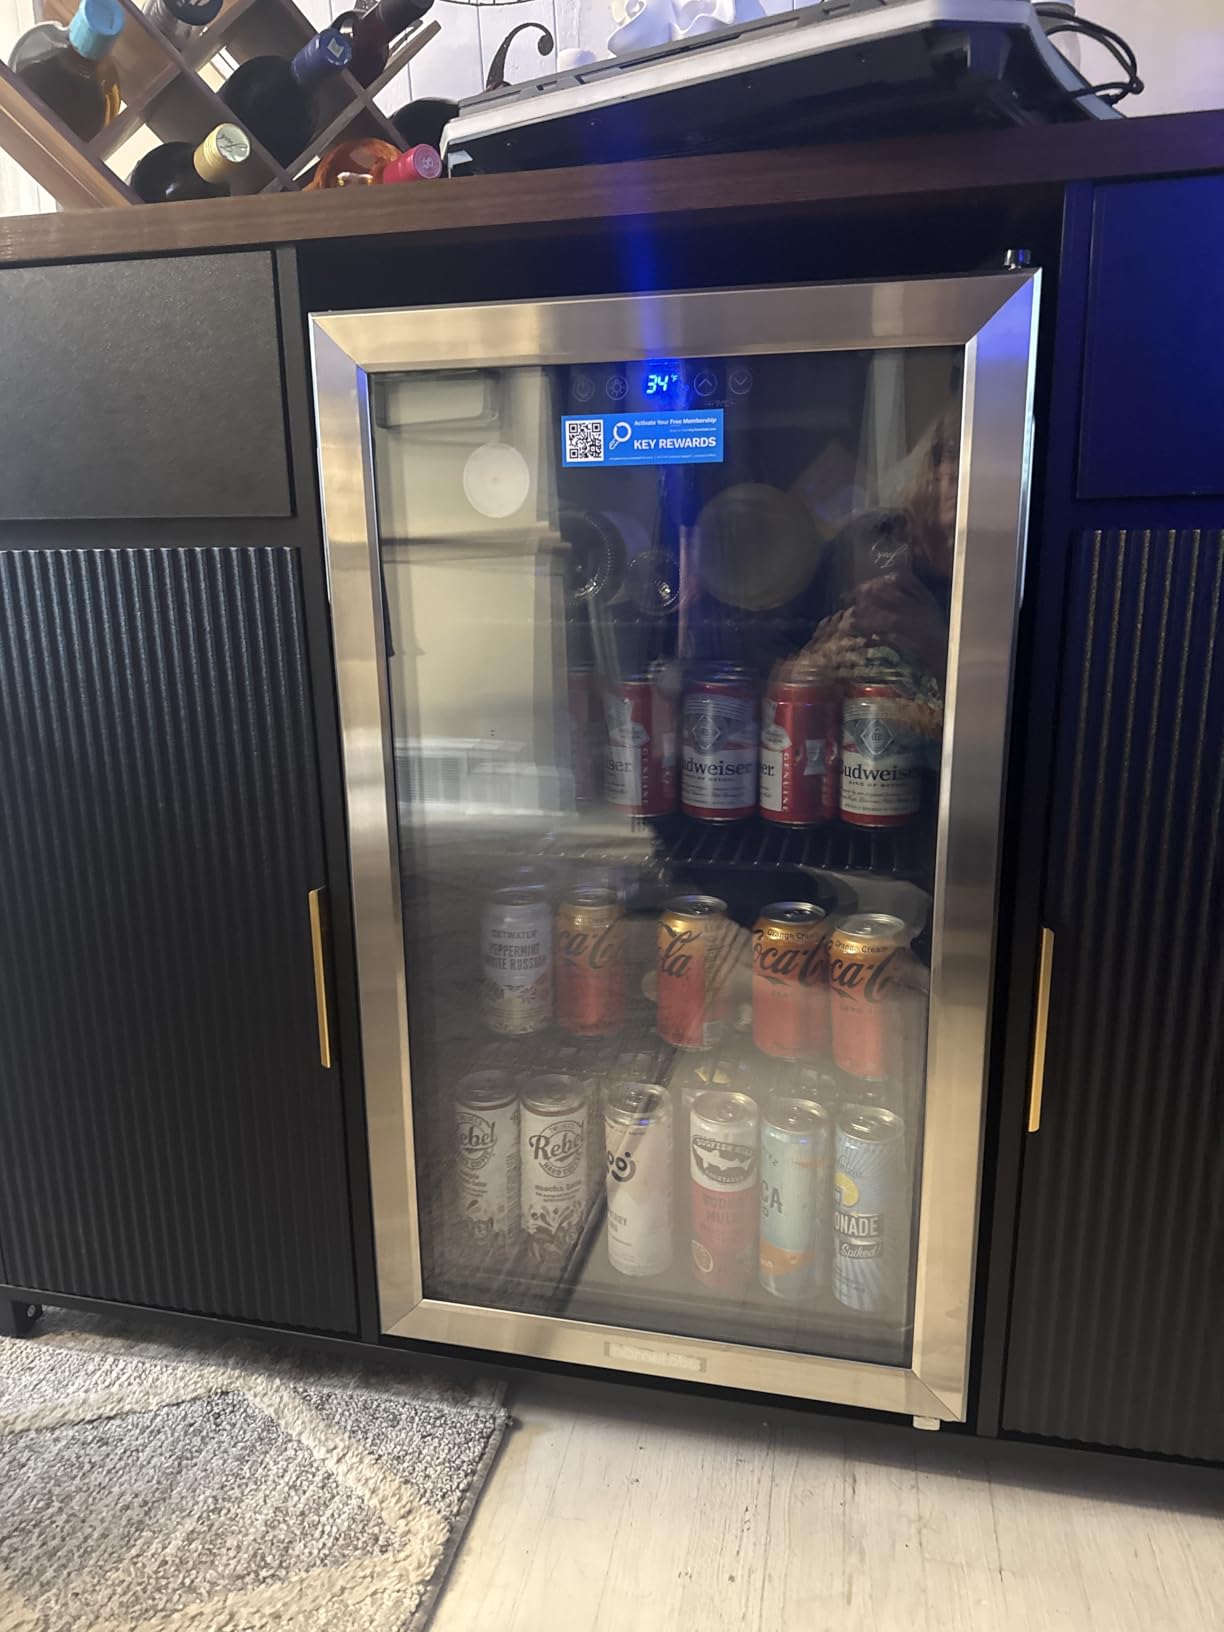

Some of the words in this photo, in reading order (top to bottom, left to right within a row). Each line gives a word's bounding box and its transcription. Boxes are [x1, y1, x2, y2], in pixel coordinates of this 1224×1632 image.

[634, 419, 657, 427] Activate
[670, 418, 682, 426] Free
[682, 416, 718, 425] Membership
[633, 438, 656, 450] KEY
[658, 436, 717, 449] REWARDS
[783, 751, 793, 812] GENUINE
[487, 942, 541, 958] PEPPERMINT
